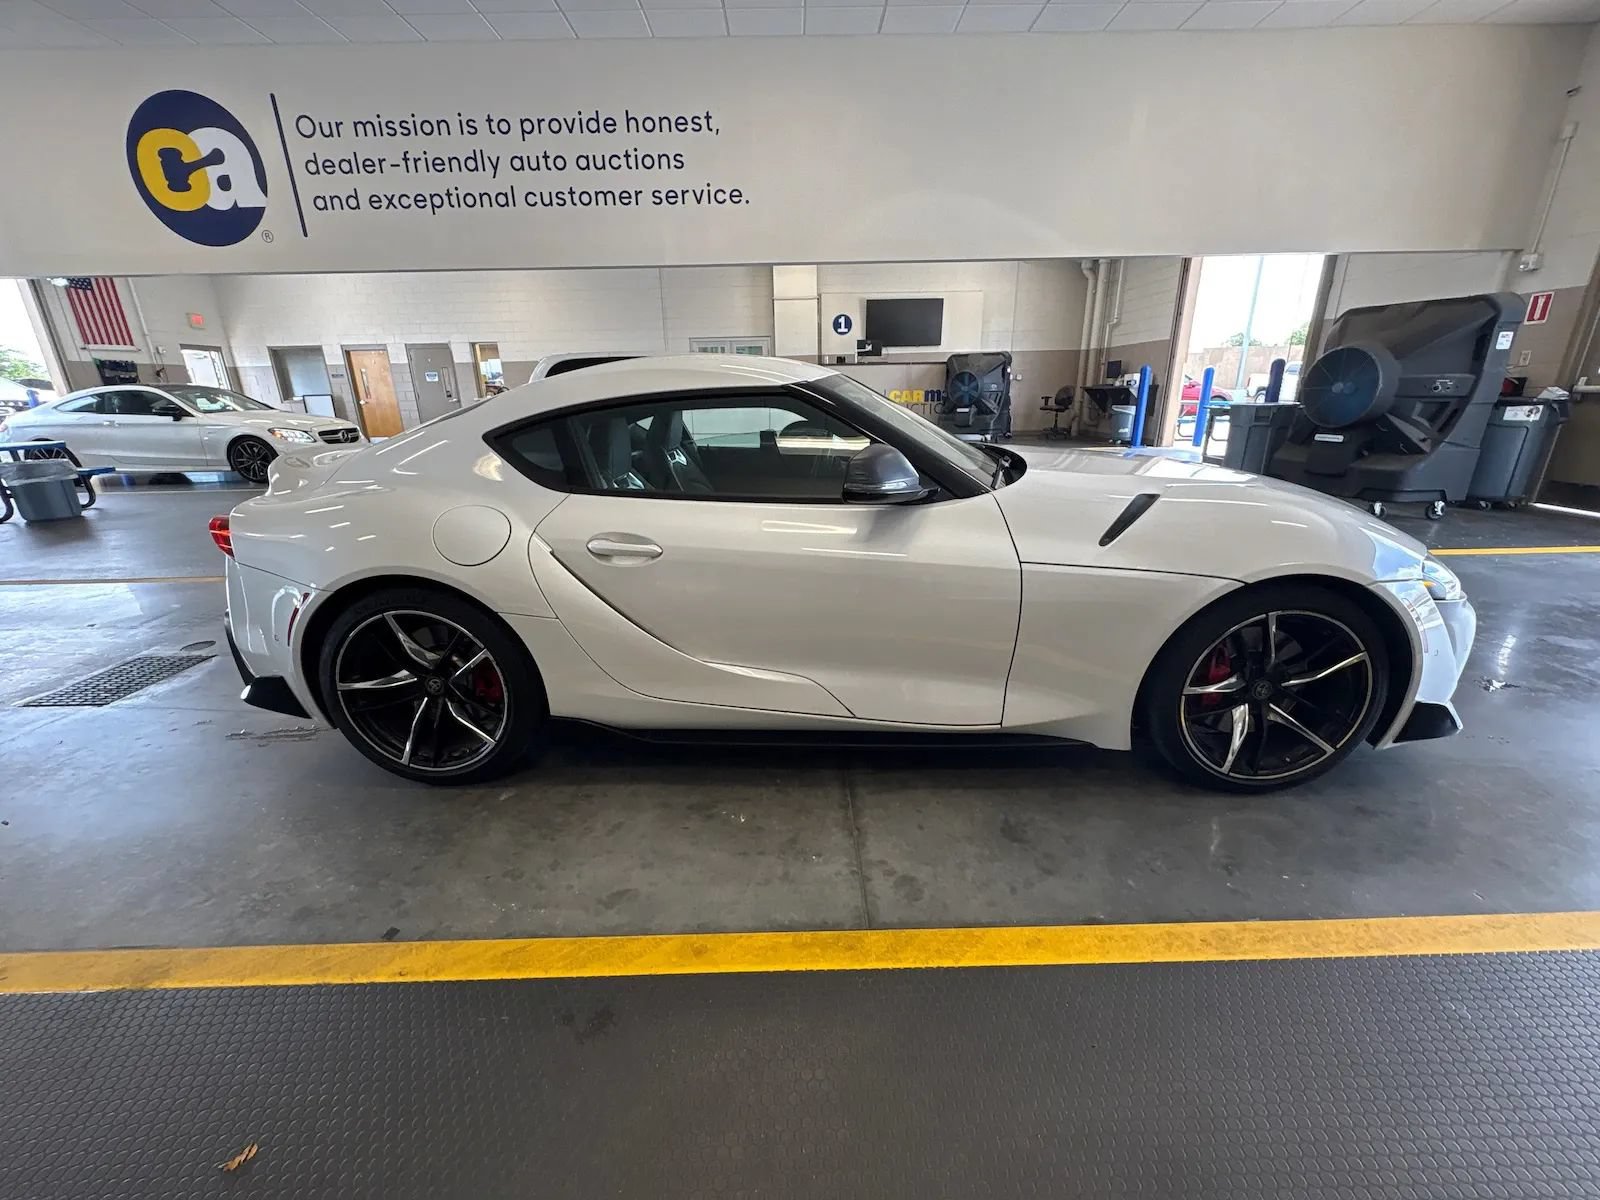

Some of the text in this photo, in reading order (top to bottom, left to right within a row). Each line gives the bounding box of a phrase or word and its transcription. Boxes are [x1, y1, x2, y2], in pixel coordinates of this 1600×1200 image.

[295, 109, 720, 142] Our mission is to provide honest,
[304, 147, 685, 180] dealer-friendly auto auctions
[312, 184, 750, 216] and exceptional customer service.
[837, 316, 849, 333] 1
[889, 388, 948, 404] CARm
